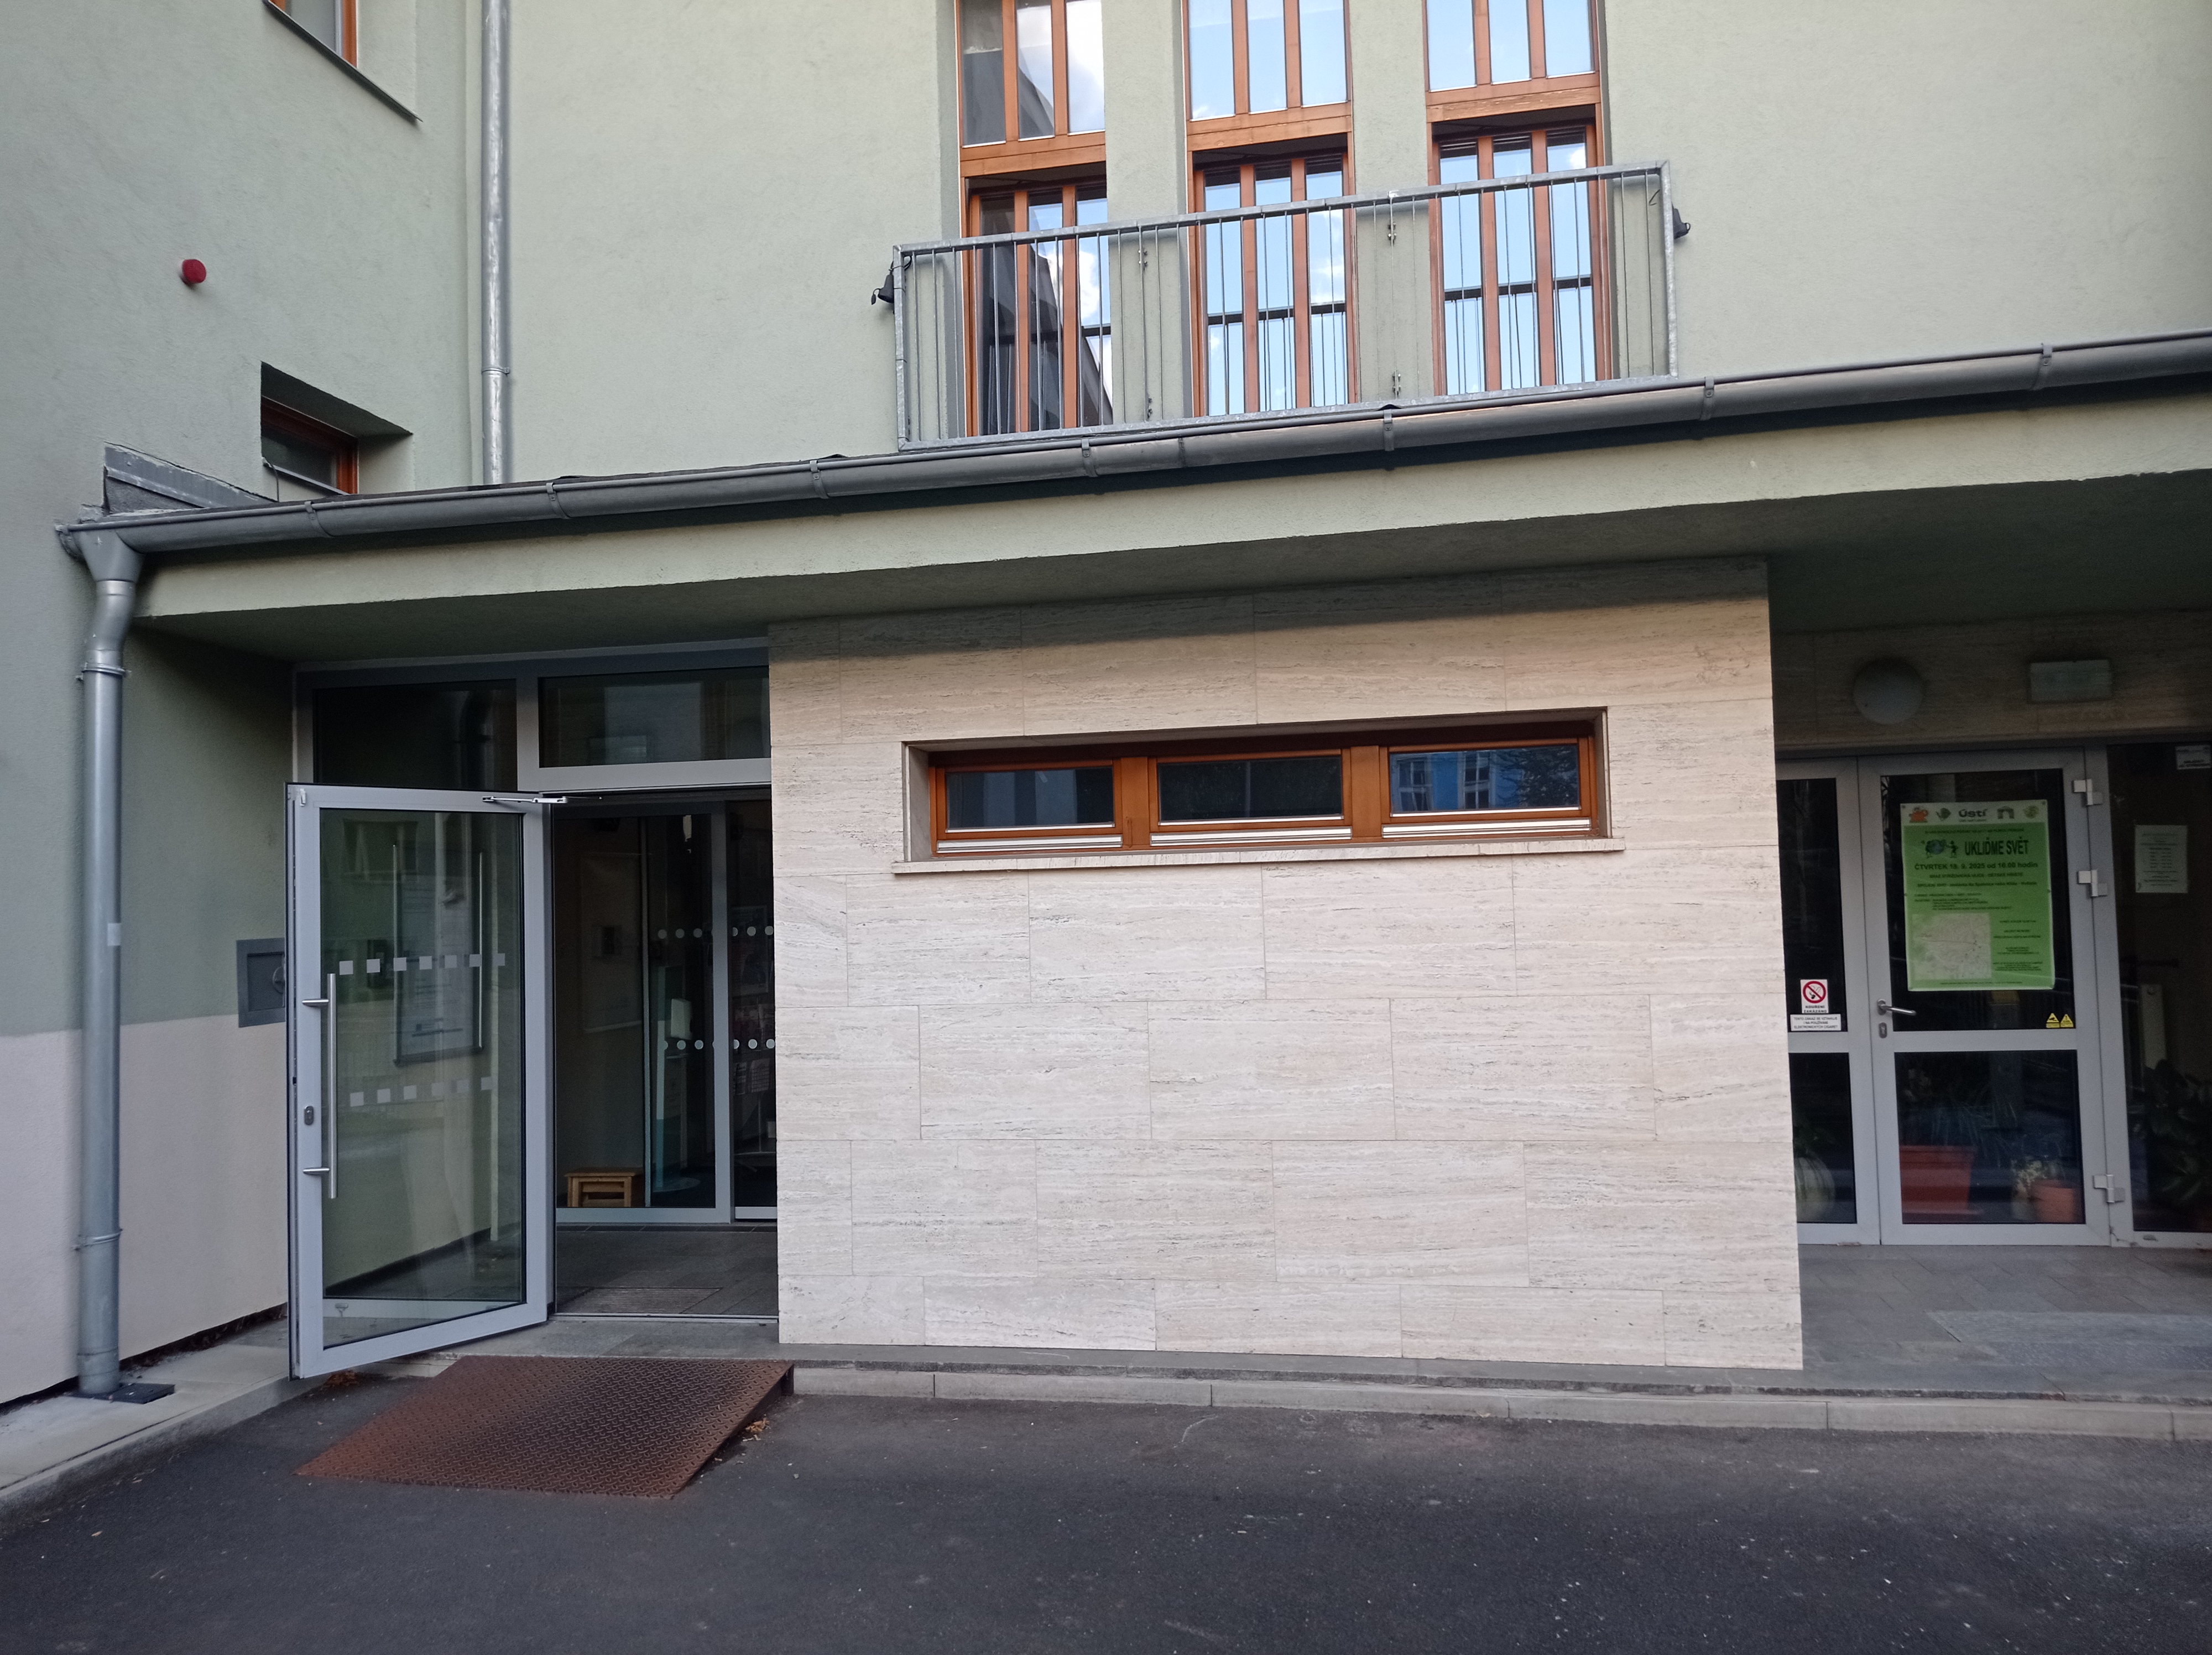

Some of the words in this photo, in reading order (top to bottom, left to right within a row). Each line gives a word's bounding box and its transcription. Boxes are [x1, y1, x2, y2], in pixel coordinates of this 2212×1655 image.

[1959, 809, 1988, 817] Ústí
[1964, 837, 2004, 856] UKLIĎME
[2006, 836, 2029, 855] SVĚT
